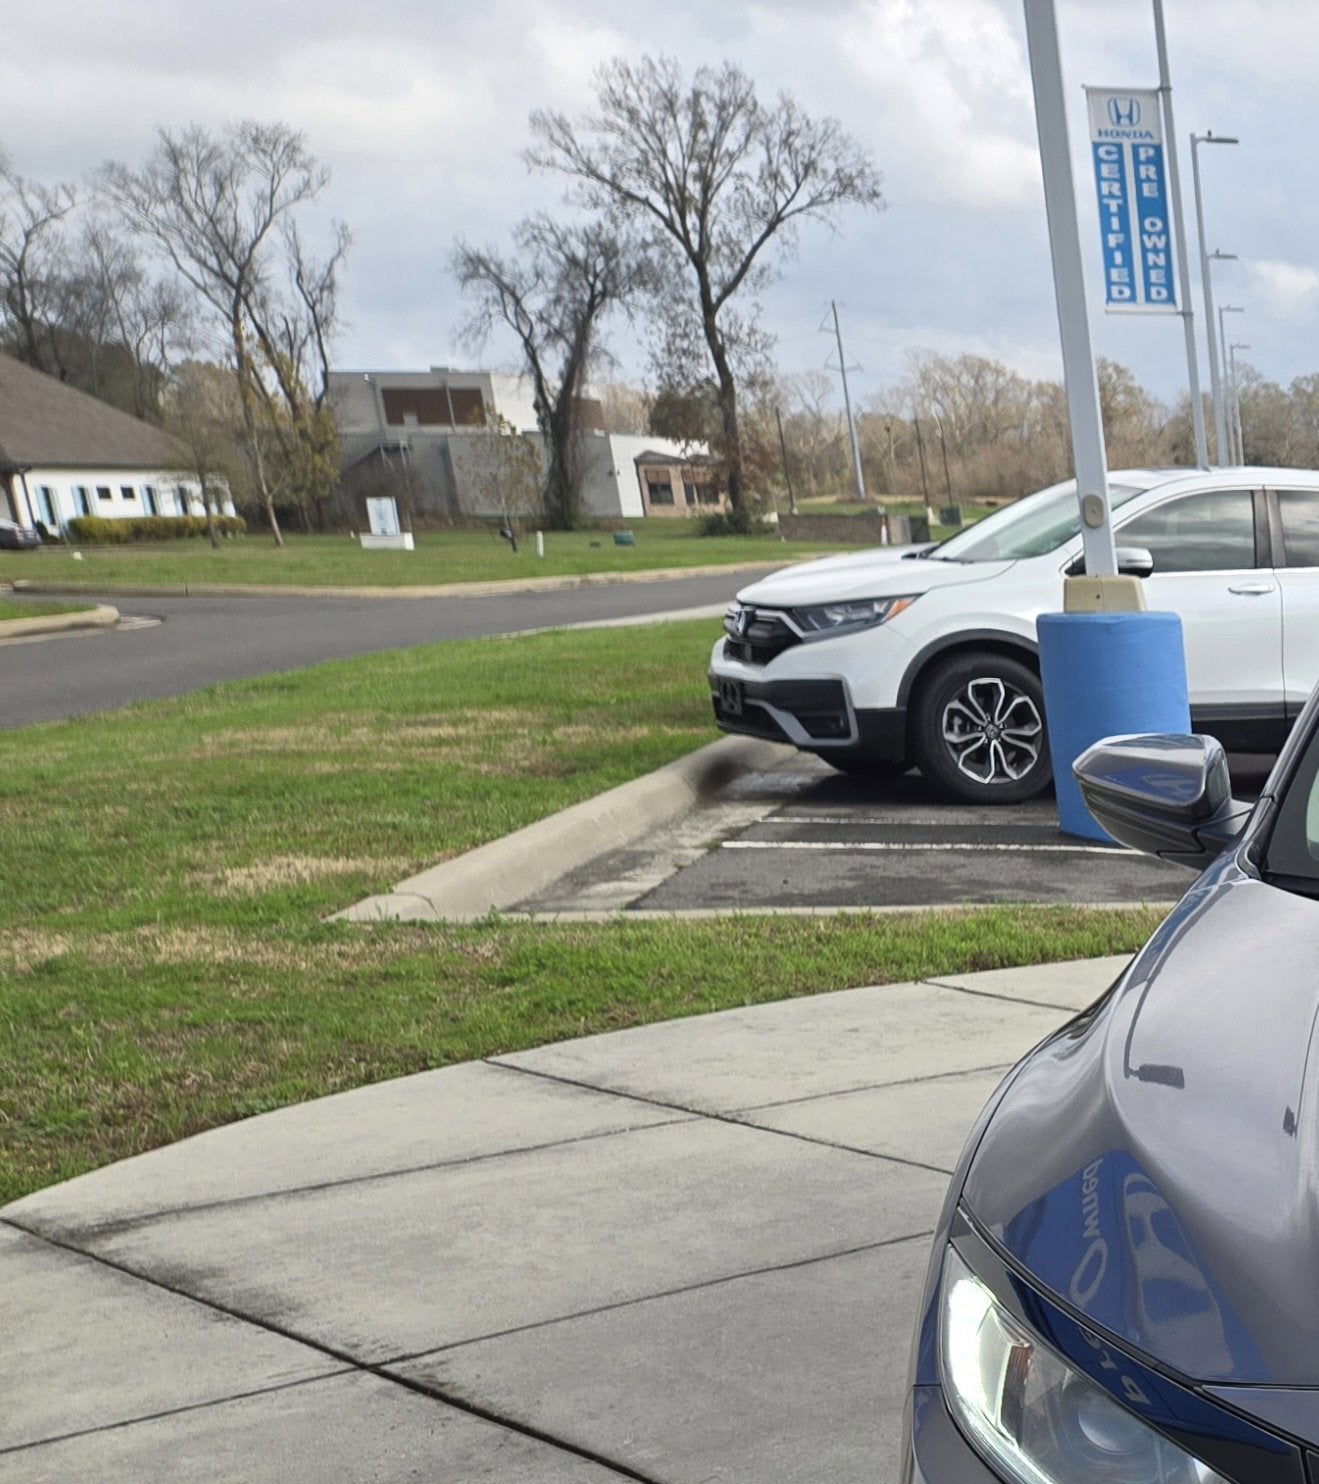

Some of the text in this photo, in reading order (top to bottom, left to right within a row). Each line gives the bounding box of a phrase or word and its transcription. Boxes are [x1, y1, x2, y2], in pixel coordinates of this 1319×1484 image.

[1096, 128, 1154, 140] HONDA
[1097, 145, 1132, 300] CERTIFIED
[1138, 147, 1168, 300] PRE OWNED
